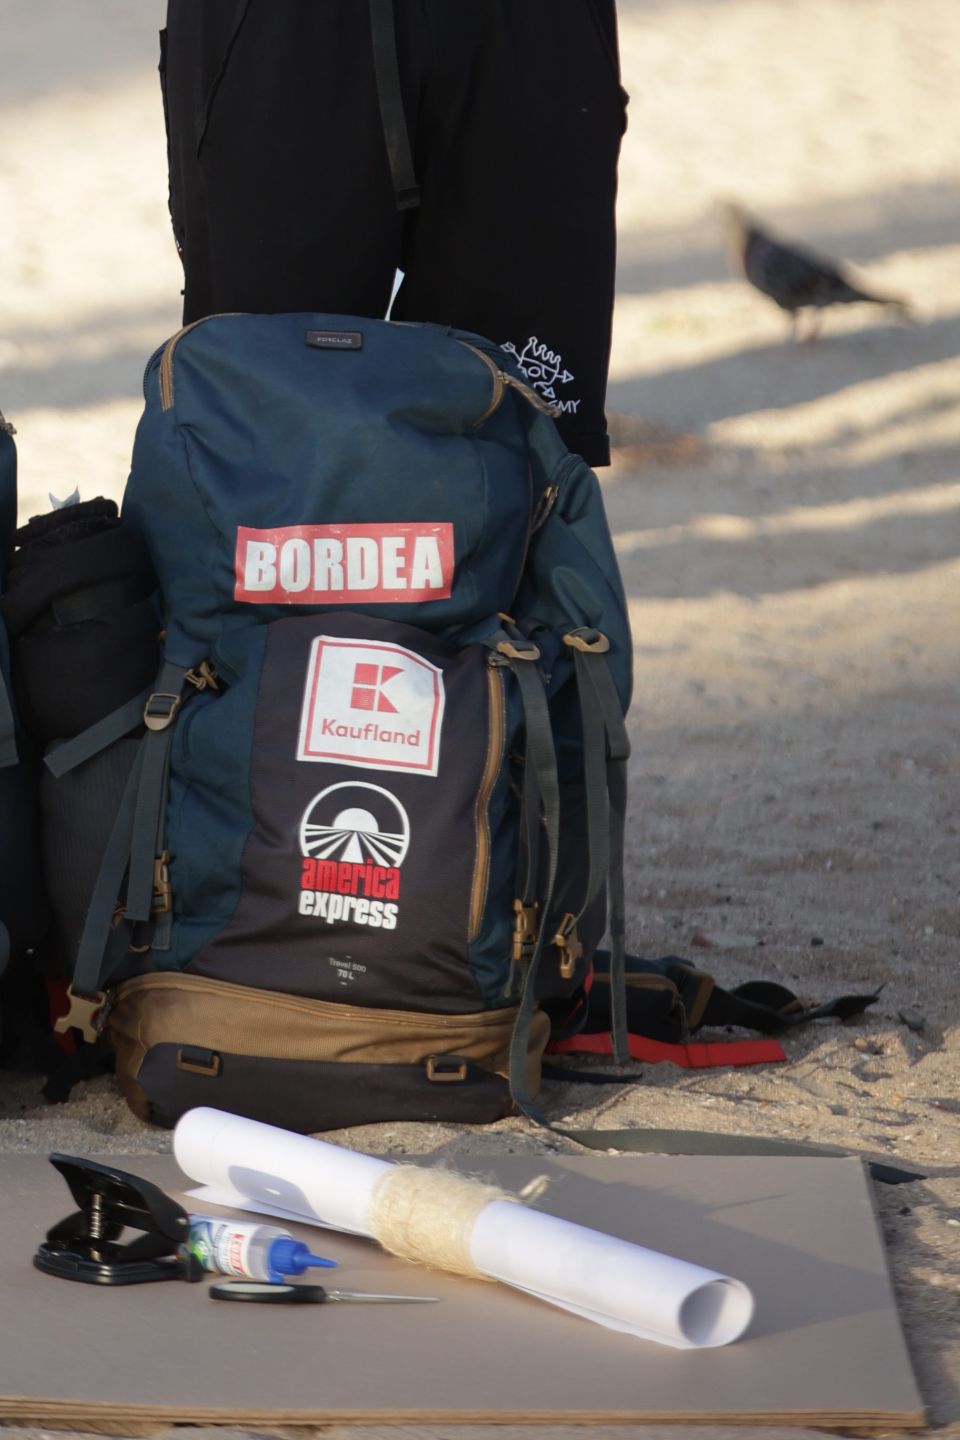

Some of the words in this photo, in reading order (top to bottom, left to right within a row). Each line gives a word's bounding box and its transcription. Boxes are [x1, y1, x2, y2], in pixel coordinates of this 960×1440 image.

[244, 536, 444, 593] BORDEA
[321, 718, 421, 747] Kaufland
[301, 856, 401, 899] america
[298, 889, 399, 930] express
